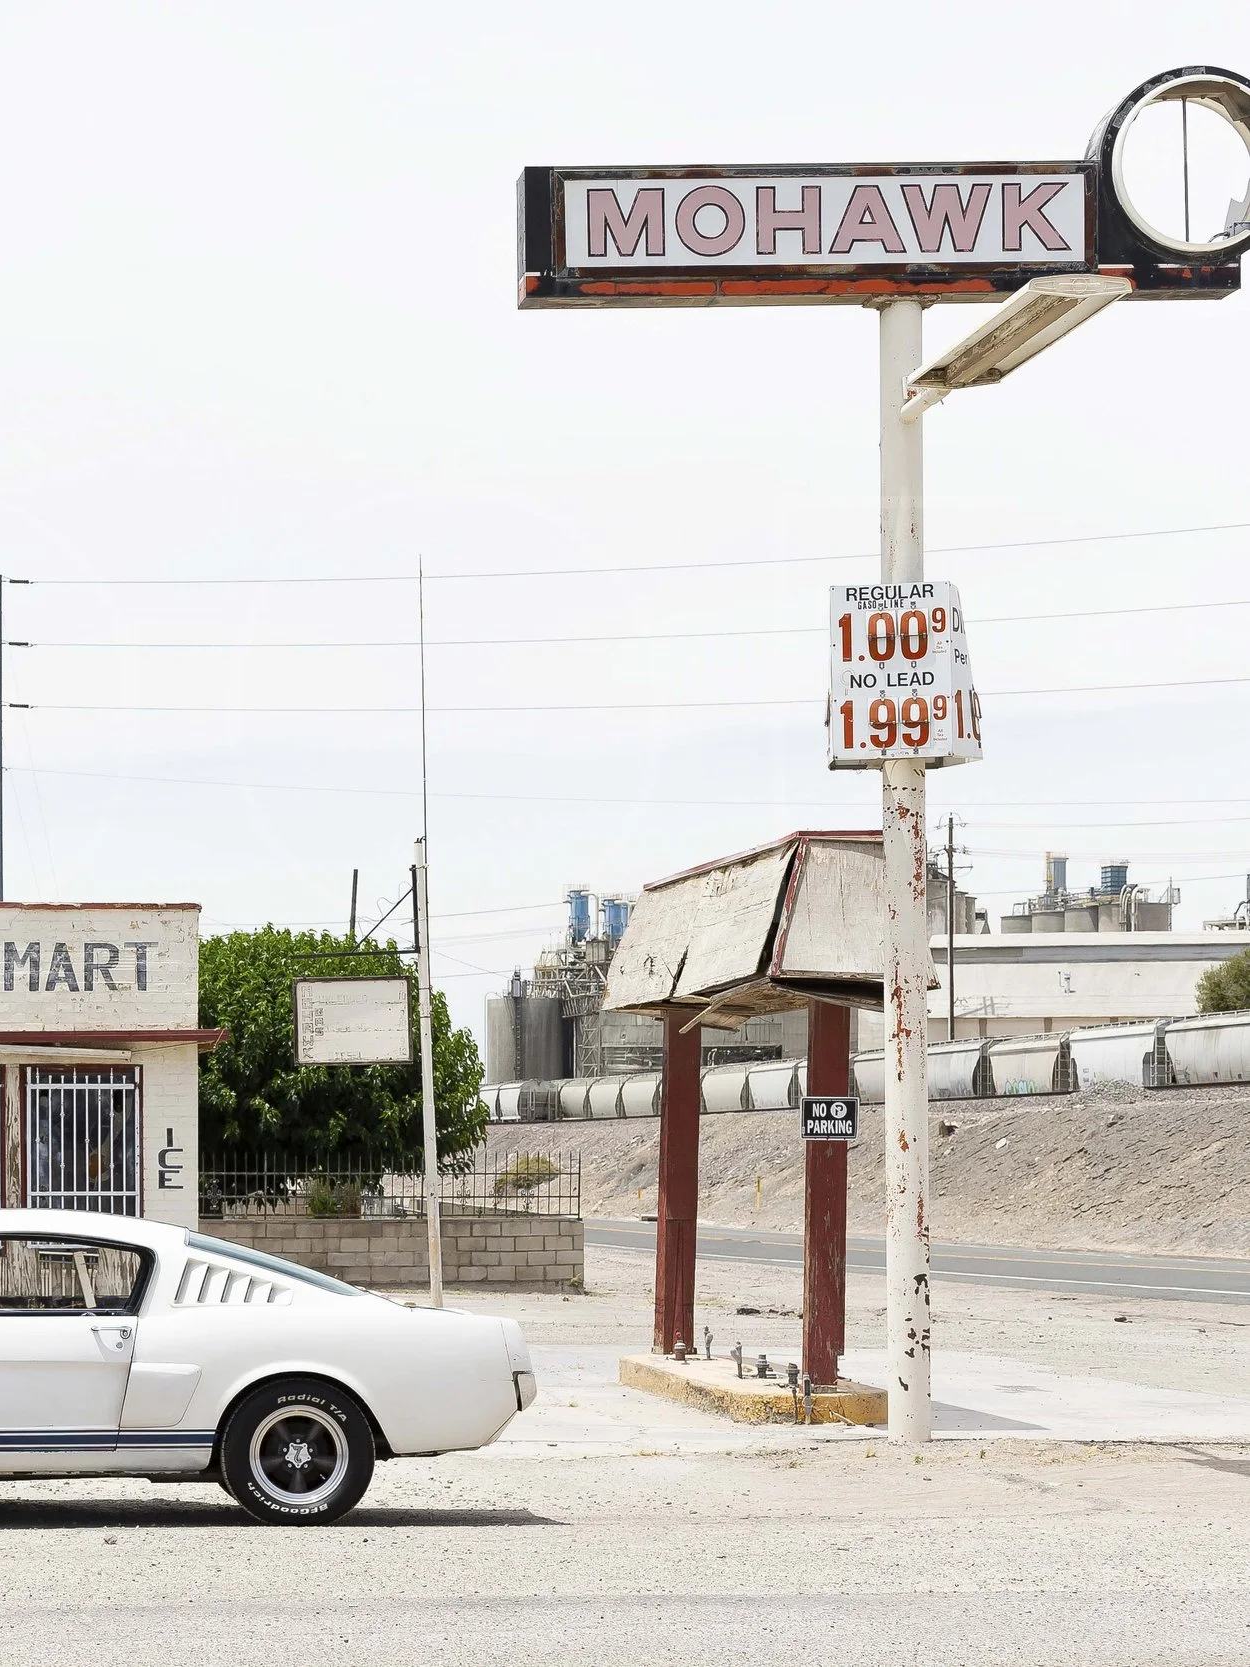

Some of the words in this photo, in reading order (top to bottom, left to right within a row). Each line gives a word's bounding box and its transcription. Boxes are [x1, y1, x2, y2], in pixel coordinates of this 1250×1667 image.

[586, 182, 1072, 257] MOHAWK
[846, 583, 934, 601] REGULAR
[850, 673, 877, 689] NO
[887, 671, 935, 688] LEAD
[812, 1103, 827, 1118] NO
[807, 1120, 853, 1134] PARKING
[157, 1127, 184, 1190] ICE
[277, 1394, 326, 1405] Radial
[329, 1404, 348, 1423] T/A
[247, 1482, 329, 1515] BFGoodrich
